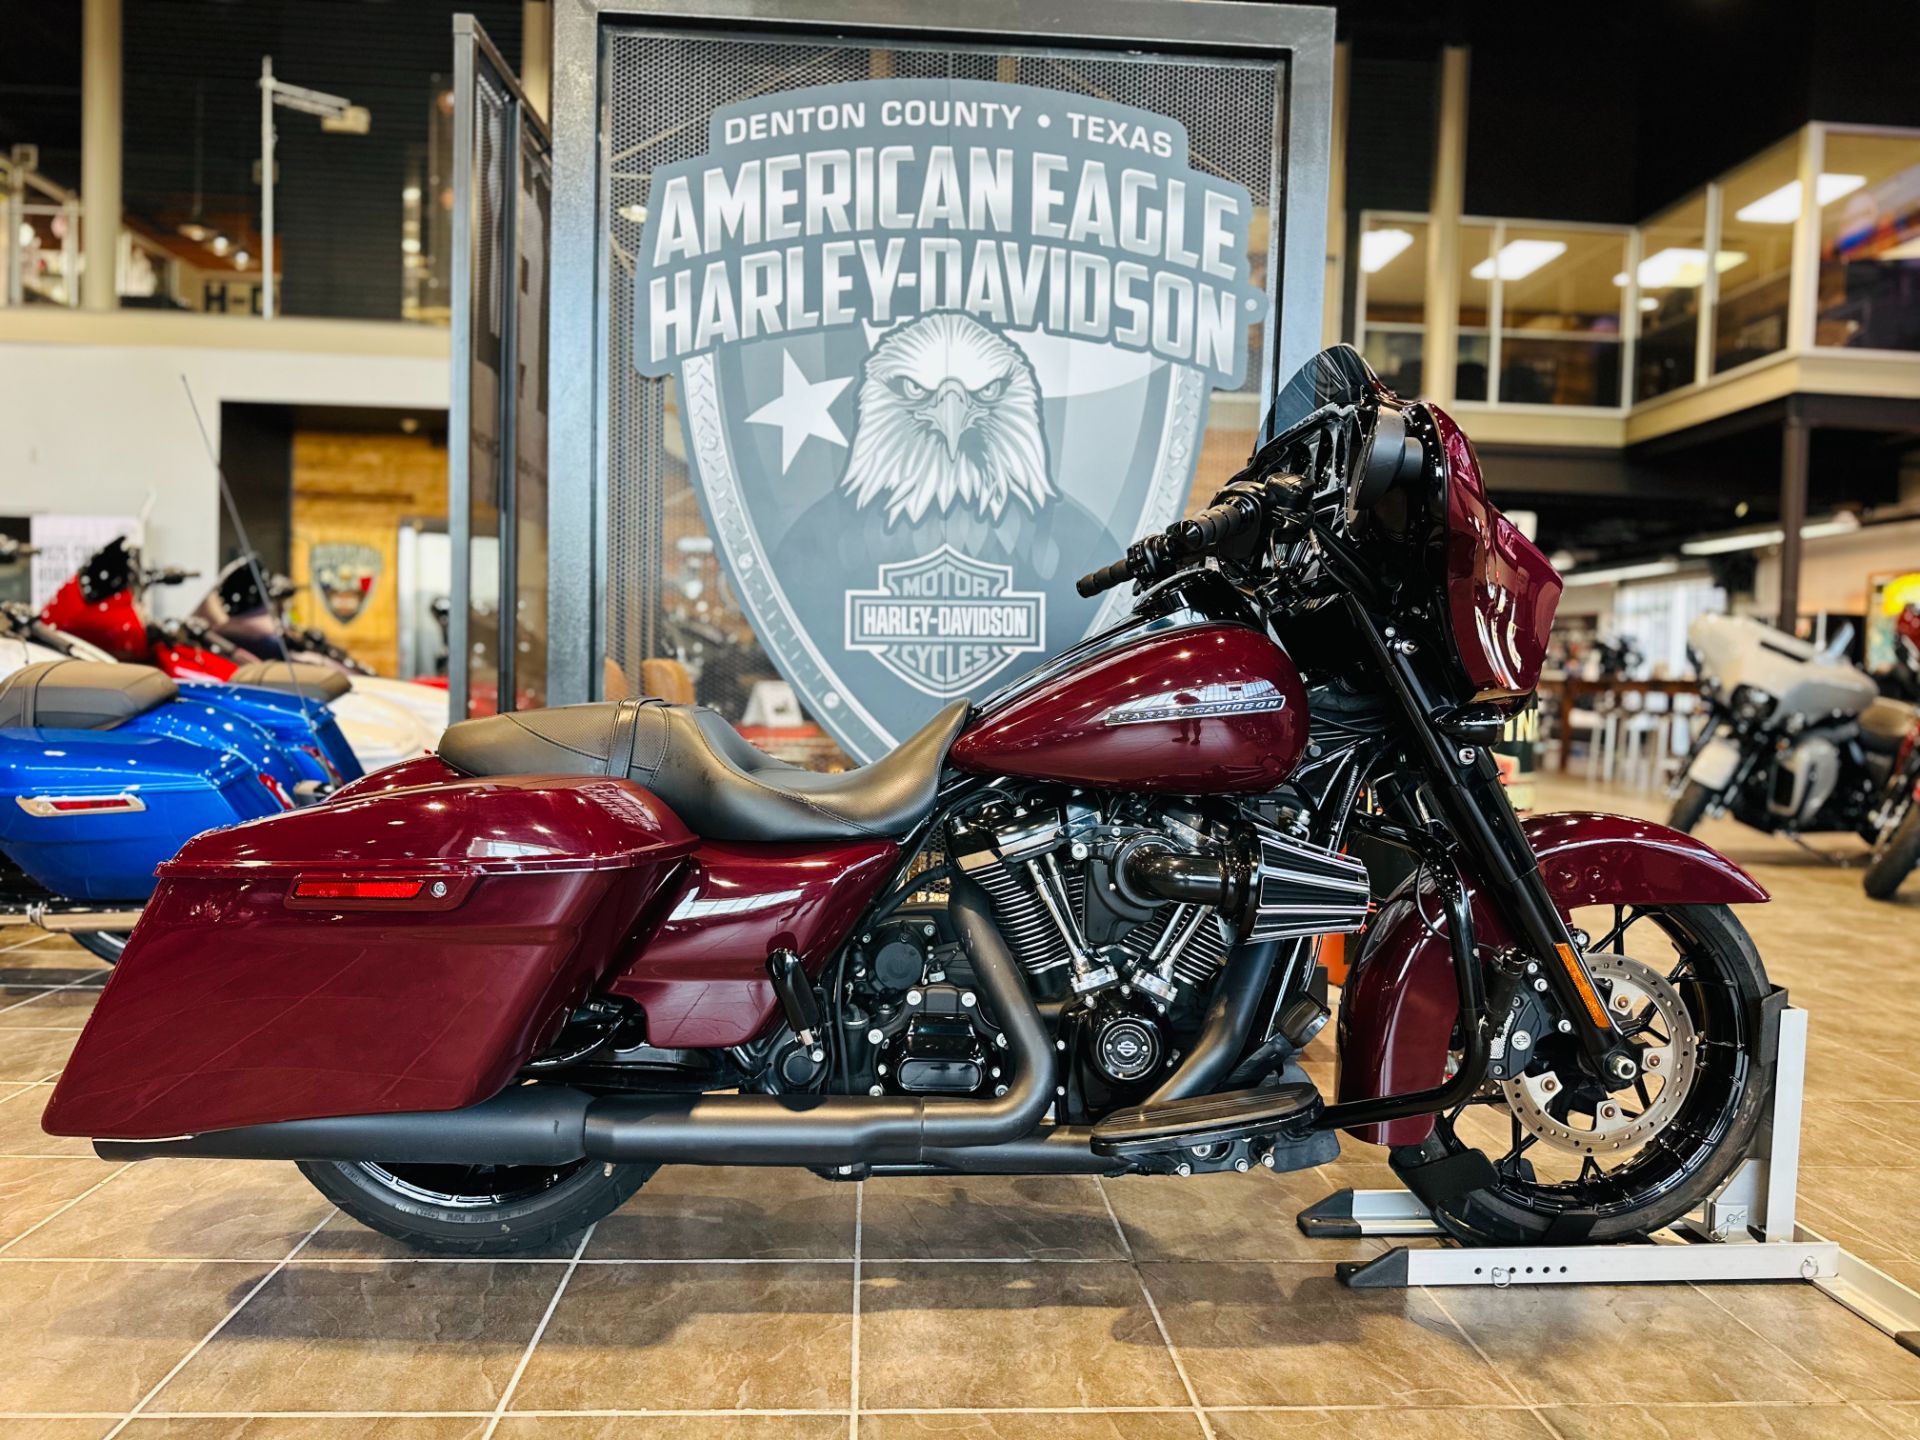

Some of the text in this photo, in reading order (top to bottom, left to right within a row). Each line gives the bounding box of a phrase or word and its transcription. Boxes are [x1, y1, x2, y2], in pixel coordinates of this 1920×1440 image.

[724, 100, 1173, 158] DENTON COUNTY TEXAS
[652, 145, 1239, 280] AMERICAN EAGLE
[649, 237, 1236, 376] HARLEY-DAVIDSON
[902, 564, 990, 598] MOTOR
[863, 605, 1028, 637] HARLEY-DAVIDSON
[900, 645, 990, 682] CYCLES
